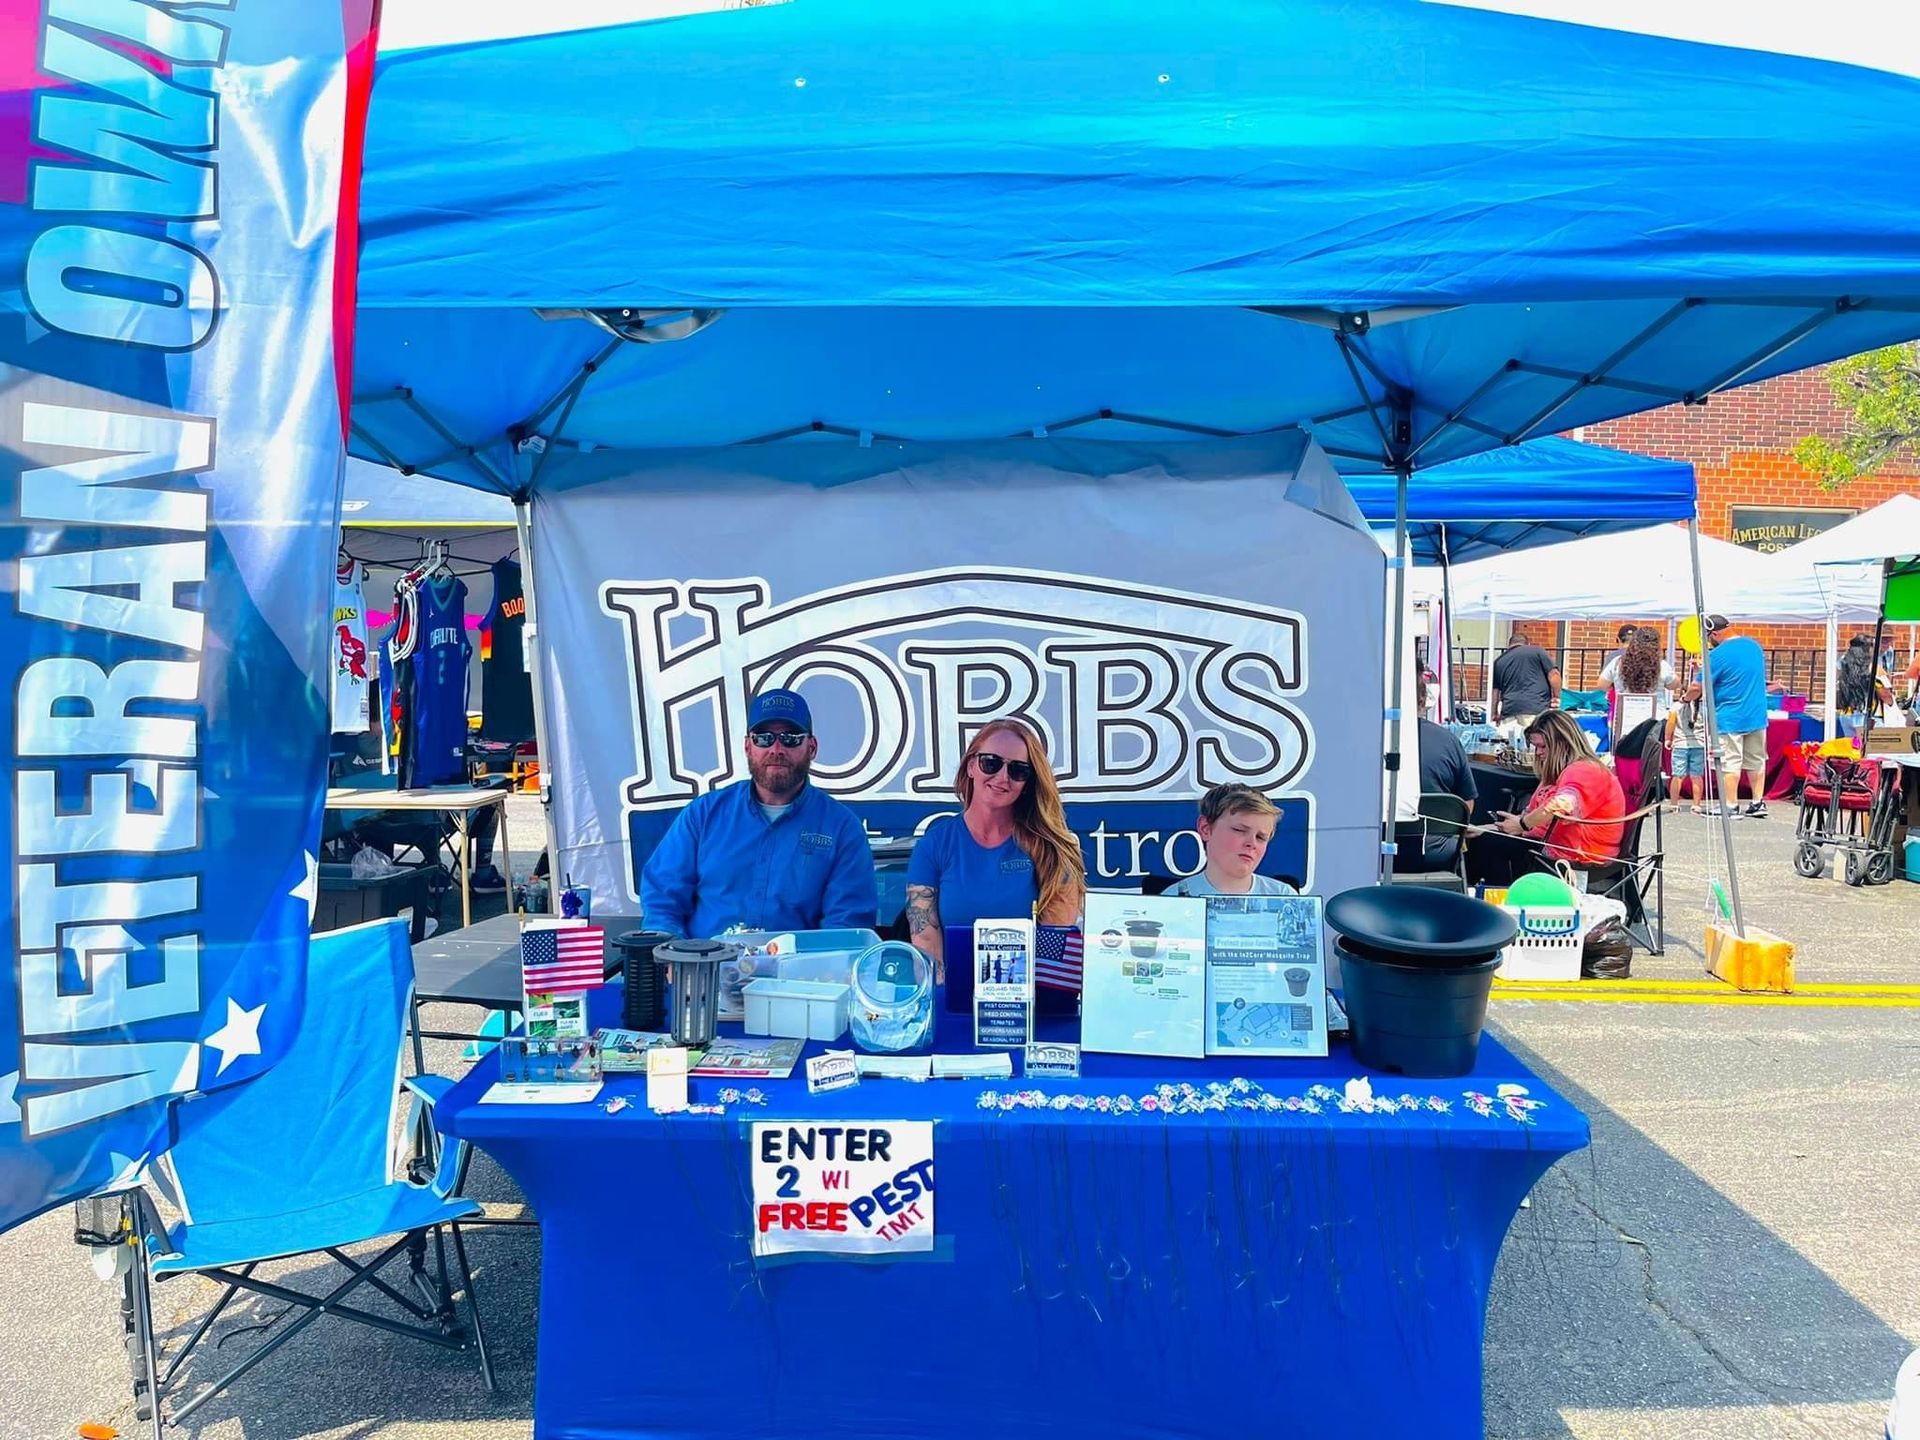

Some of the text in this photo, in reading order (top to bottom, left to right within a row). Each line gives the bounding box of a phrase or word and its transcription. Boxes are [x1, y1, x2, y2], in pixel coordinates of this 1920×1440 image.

[1731, 523, 1822, 544] AMERICAN LEG
[15, 0, 236, 1140] VETERAN OWN
[335, 607, 358, 623] WKS
[502, 597, 525, 618] BOO
[603, 570, 1311, 804] HOBBS
[978, 927, 1026, 943] HOBBS
[1267, 951, 1295, 960] Mosquito
[1296, 952, 1311, 961] Trap
[1027, 1045, 1076, 1063] HOBBS
[761, 1127, 892, 1163] ENTER
[775, 1164, 801, 1198] 2
[758, 1158, 934, 1233] FREE PEST
[876, 1202, 926, 1242] TMT
